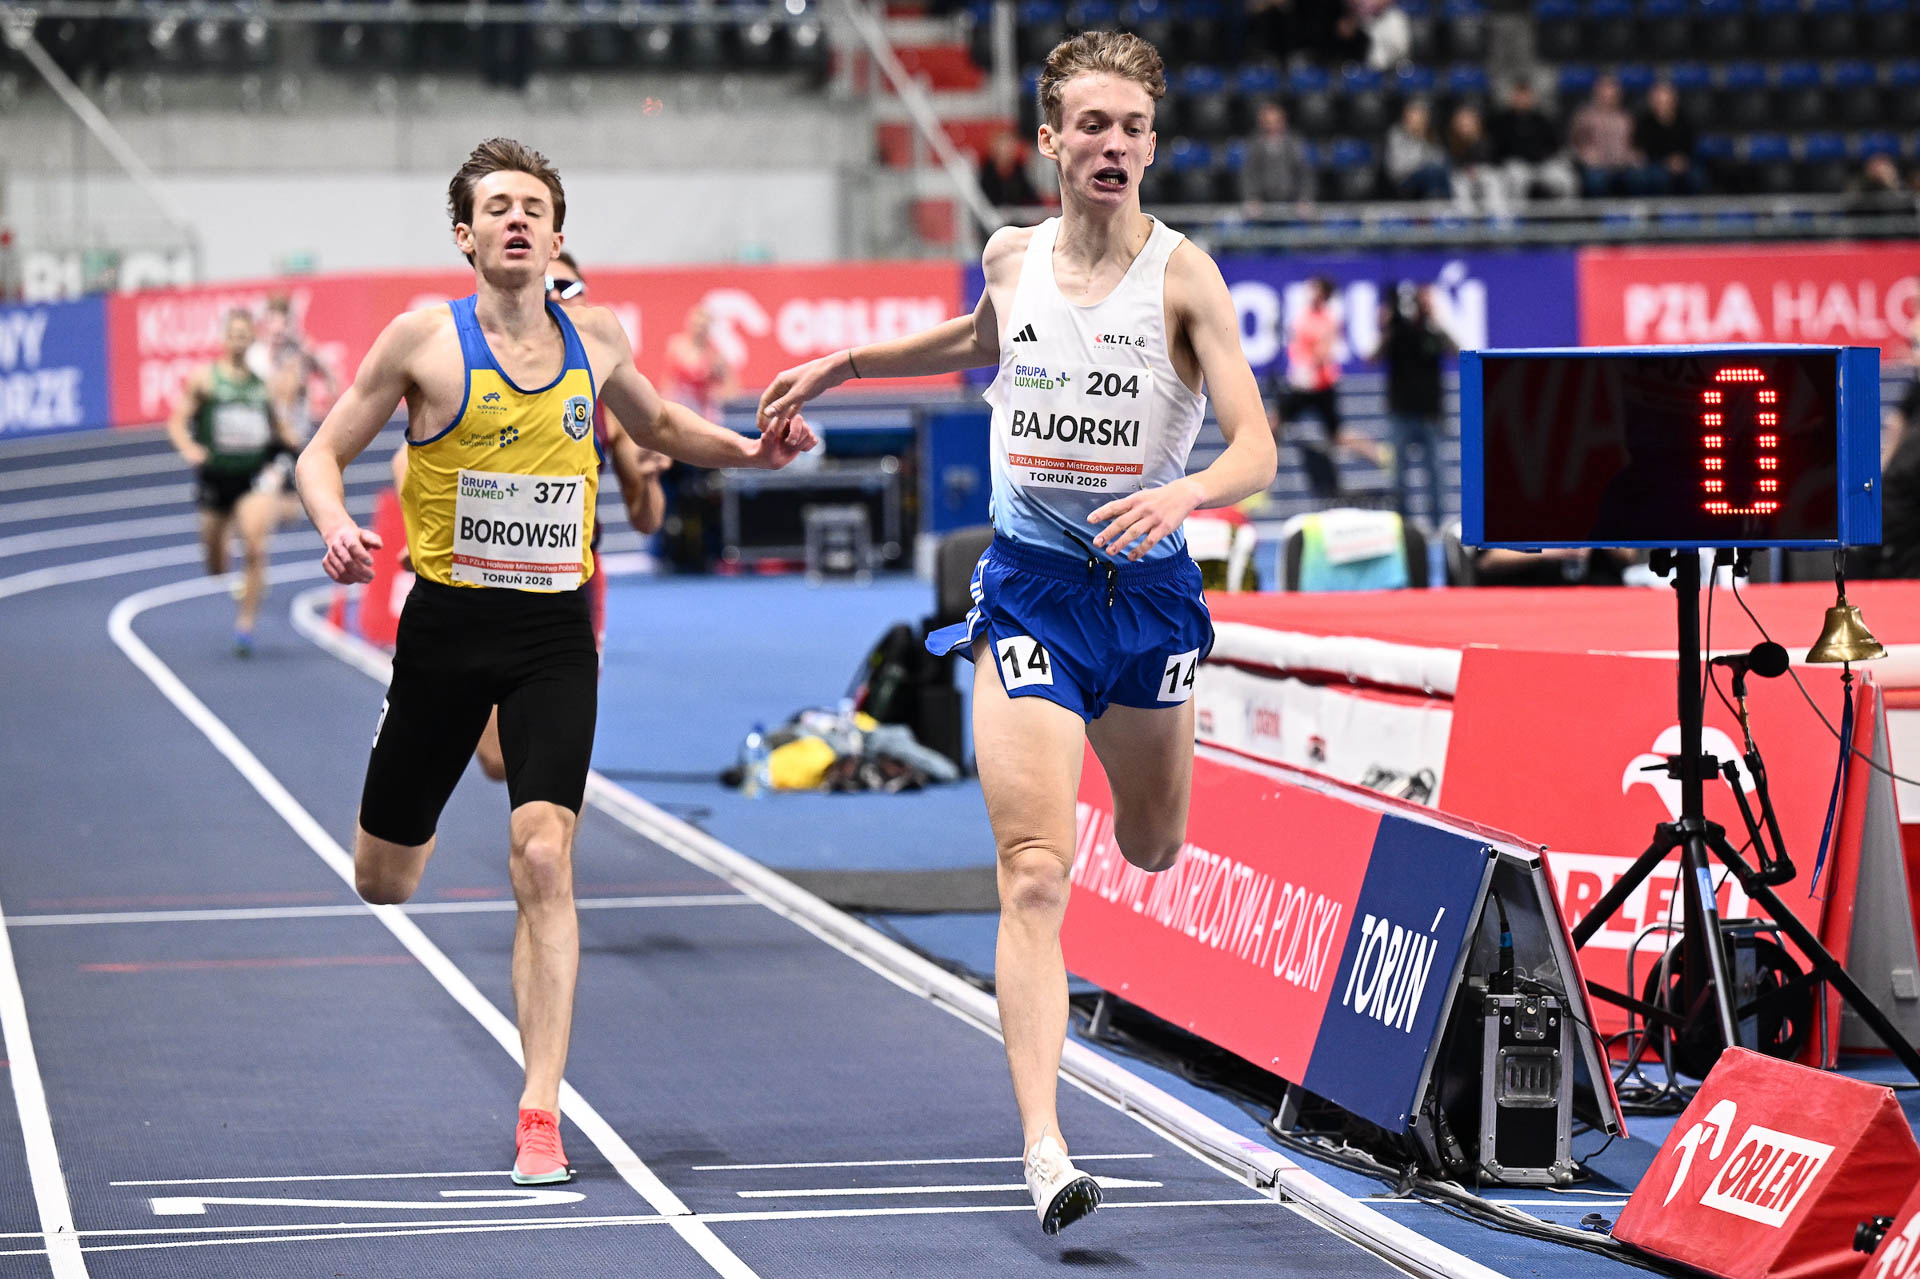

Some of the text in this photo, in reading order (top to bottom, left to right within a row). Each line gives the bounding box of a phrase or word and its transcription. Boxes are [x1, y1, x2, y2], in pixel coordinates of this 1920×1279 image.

[1229, 259, 1489, 366] OUŃ
[1014, 377, 1054, 390] LUXMED
[1015, 365, 1047, 378] GRUPA
[1086, 371, 1140, 399] 204
[1011, 409, 1140, 447] BAJORSKI
[1703, 368, 1777, 515] 0
[1029, 471, 1108, 488] TORUŃ 2026
[1034, 458, 1065, 468] Halowe
[1066, 461, 1114, 473] Mistrzostwa
[1115, 465, 1137, 473] Polski
[460, 487, 504, 500] LUXMED
[461, 476, 498, 489] GRUPA
[534, 482, 577, 504] 377
[460, 516, 577, 549] BOROWSKI
[482, 572, 553, 586] TORUŃ 2026
[1002, 642, 1049, 679] 14
[1165, 656, 1197, 694] 14
[1562, 869, 1733, 938] RLE
[1259, 881, 1343, 993] POLSKI
[1343, 907, 1446, 1034] TORUŃ
[1717, 1139, 1820, 1213] ORLEN
